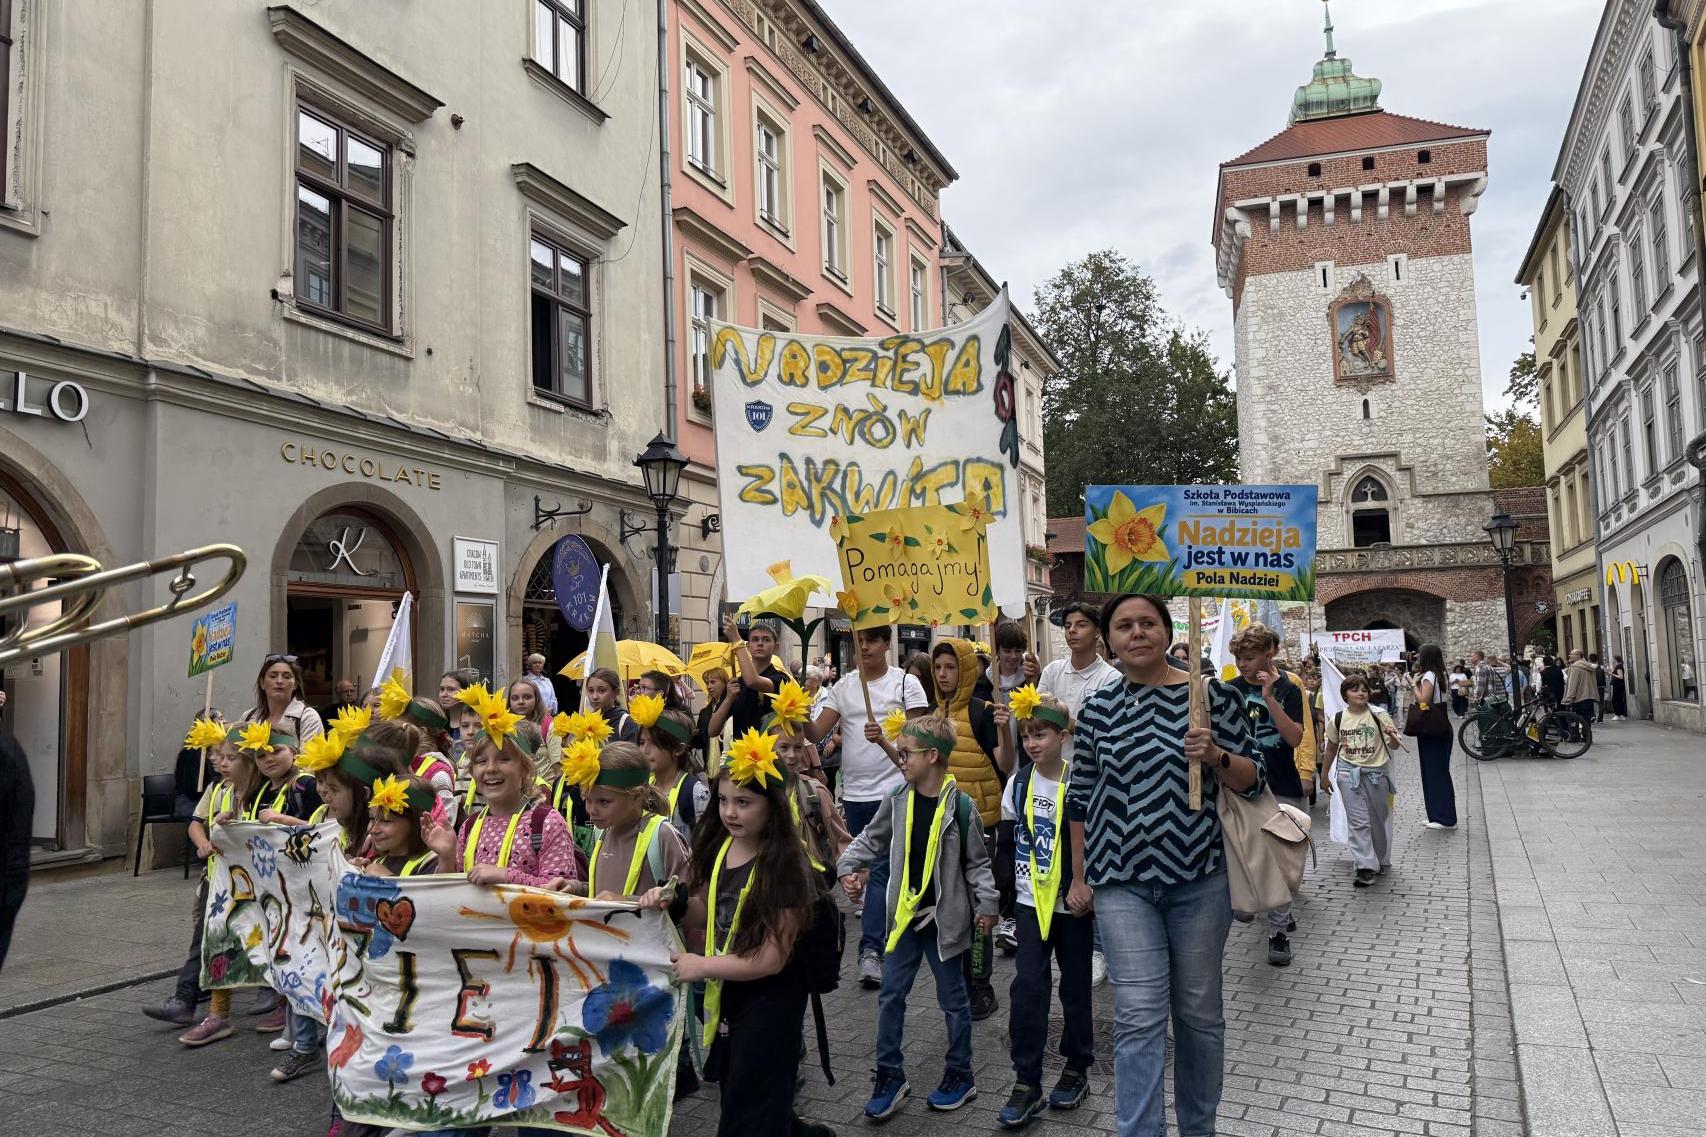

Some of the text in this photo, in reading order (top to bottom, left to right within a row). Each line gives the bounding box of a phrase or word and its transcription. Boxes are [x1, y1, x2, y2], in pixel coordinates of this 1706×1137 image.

[713, 327, 984, 400] NADZIEJA
[0, 371, 89, 422] LO
[752, 411, 766, 421] 101
[281, 441, 441, 490] CHOCOLATE
[1183, 490, 1291, 501] Szkoła Podstawowa
[1178, 521, 1301, 552] Nadzieja
[845, 538, 983, 596] Pomagajmy!
[1183, 545, 1295, 569] jest w nas
[1195, 572, 1280, 587] Pola Nadziei
[573, 592, 587, 606] 101
[1332, 632, 1372, 642] TPCH
